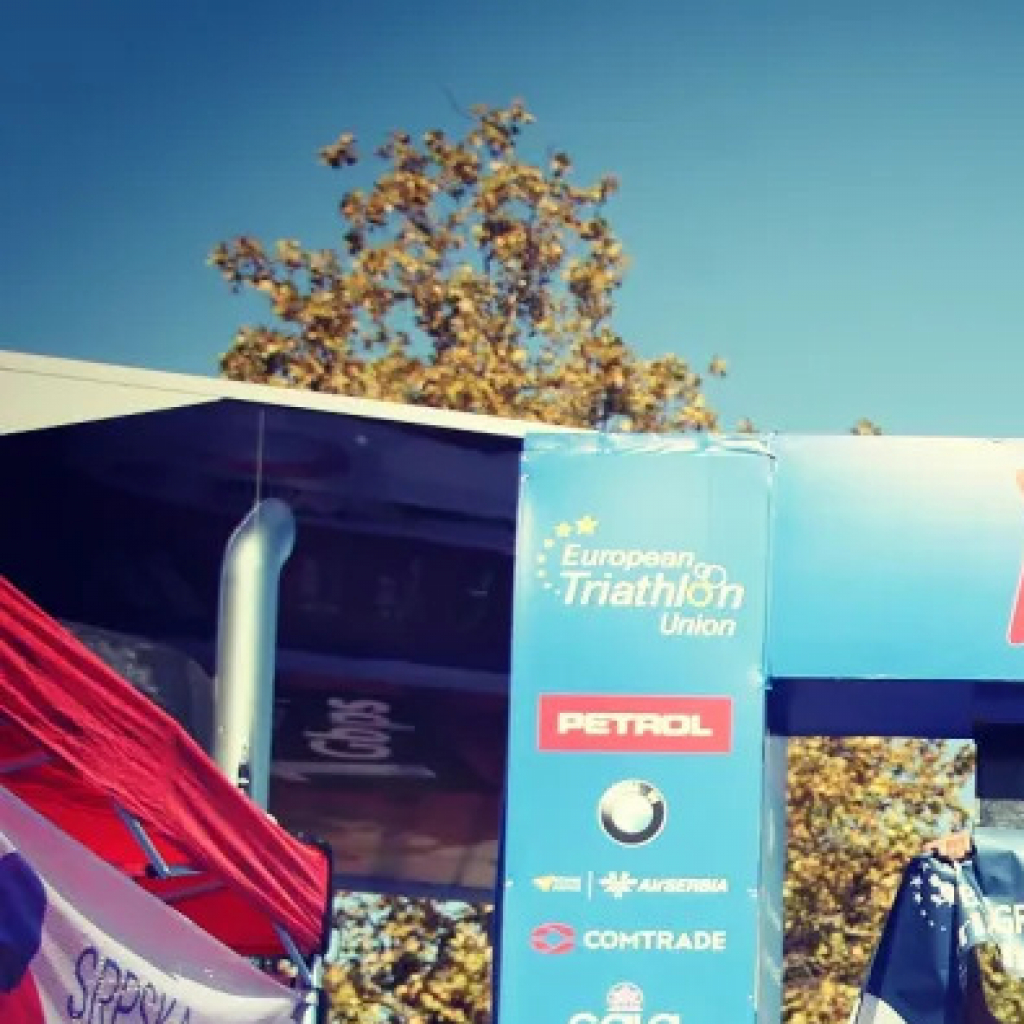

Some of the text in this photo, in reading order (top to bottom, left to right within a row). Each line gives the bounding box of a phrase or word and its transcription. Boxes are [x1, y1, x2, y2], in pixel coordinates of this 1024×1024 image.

[560, 543, 696, 571] European
[560, 571, 745, 609] Triathlon
[660, 612, 737, 636] Union
[556, 711, 714, 737] PETROL
[582, 930, 727, 951] COMTRADE
